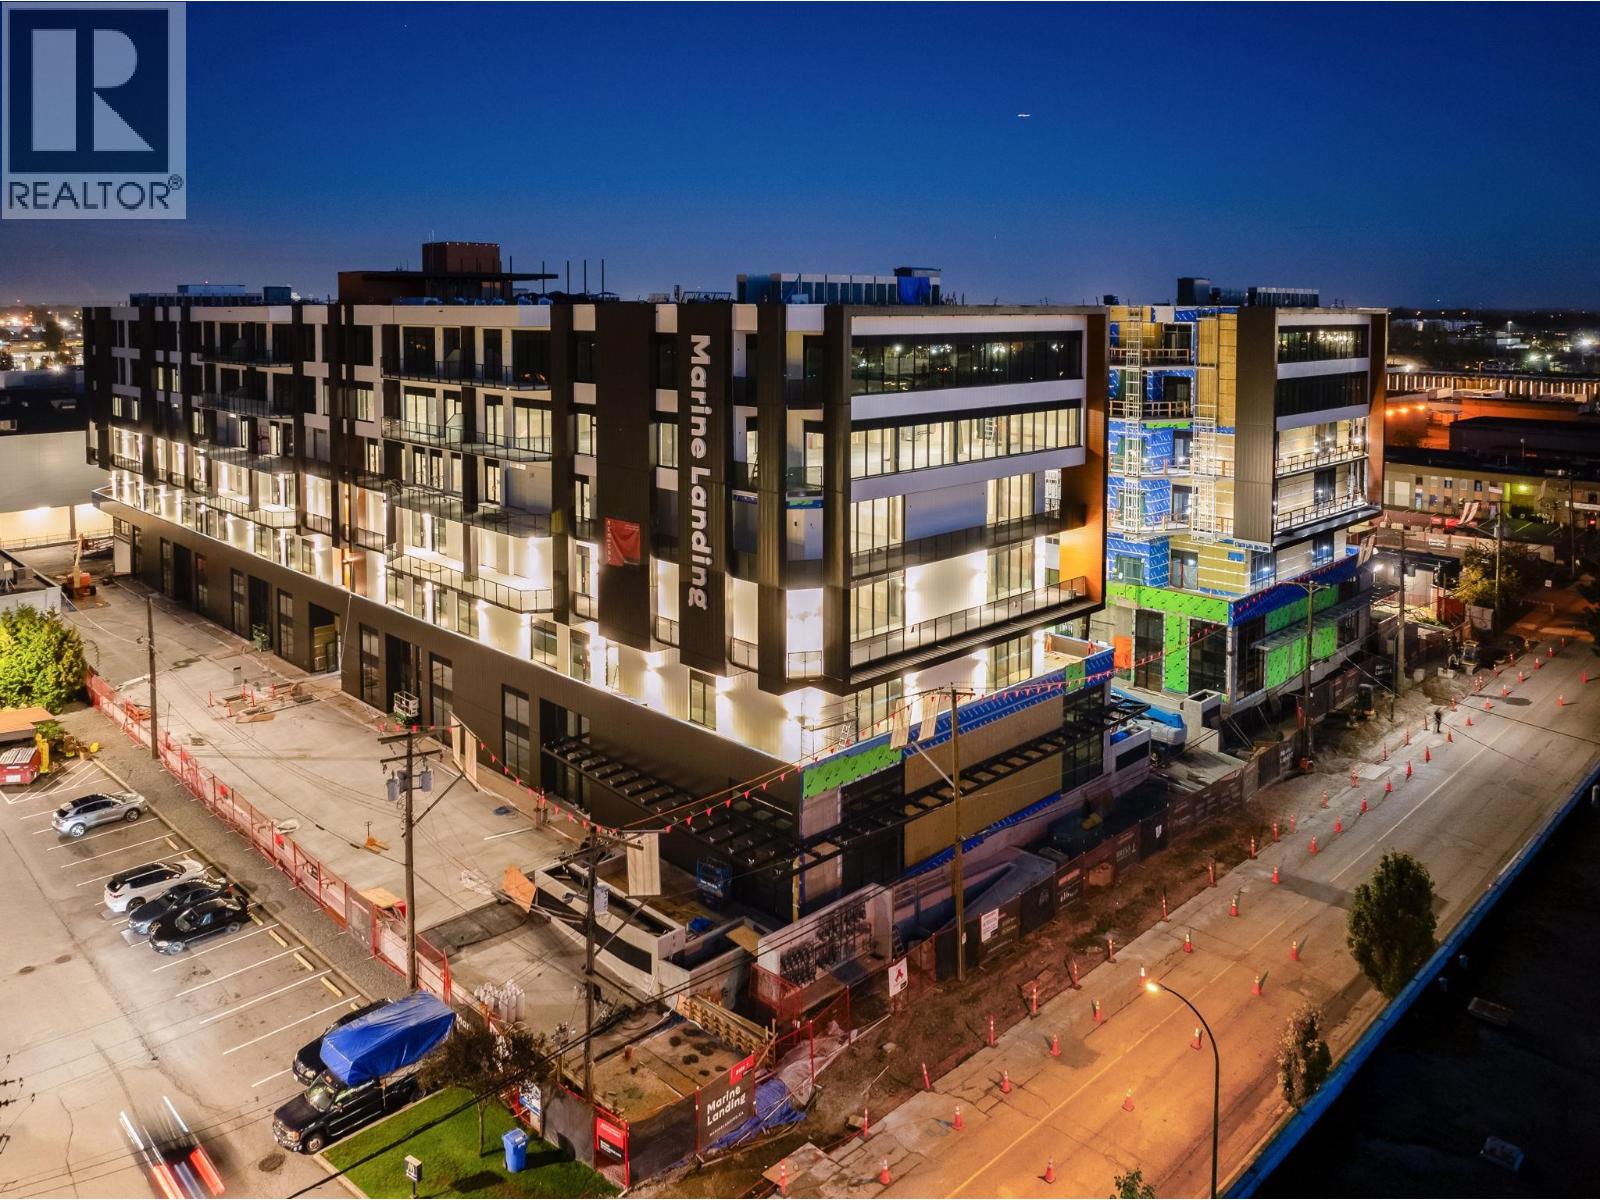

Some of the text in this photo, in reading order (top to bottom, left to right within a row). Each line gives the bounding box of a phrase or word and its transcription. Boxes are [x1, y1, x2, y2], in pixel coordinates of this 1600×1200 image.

[688, 334, 712, 610] Marine Landing
[706, 1086, 741, 1115] Marine
[706, 1092, 746, 1126] Landing
